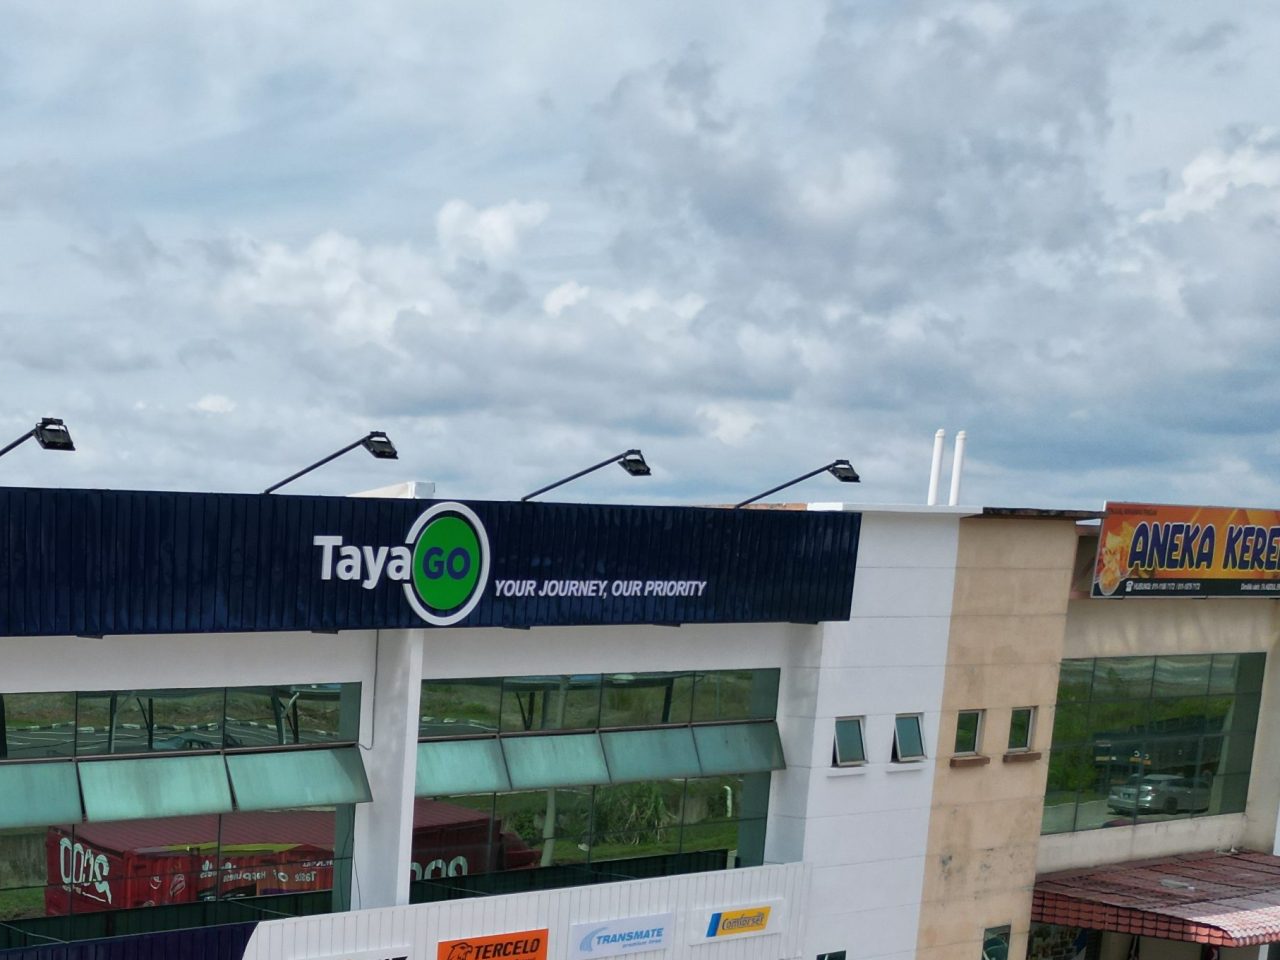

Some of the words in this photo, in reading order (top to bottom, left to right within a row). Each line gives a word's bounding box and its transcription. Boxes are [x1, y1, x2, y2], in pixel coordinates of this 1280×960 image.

[1127, 522, 1216, 570] ANEKA
[1222, 524, 1280, 570] KERE
[495, 580, 536, 597] YOUR
[538, 580, 608, 599] JOURNEY,
[611, 581, 642, 597] OUR
[644, 581, 707, 597] PRIORITY
[596, 927, 664, 945] TRANSMATE
[474, 938, 540, 960] TERCELO
